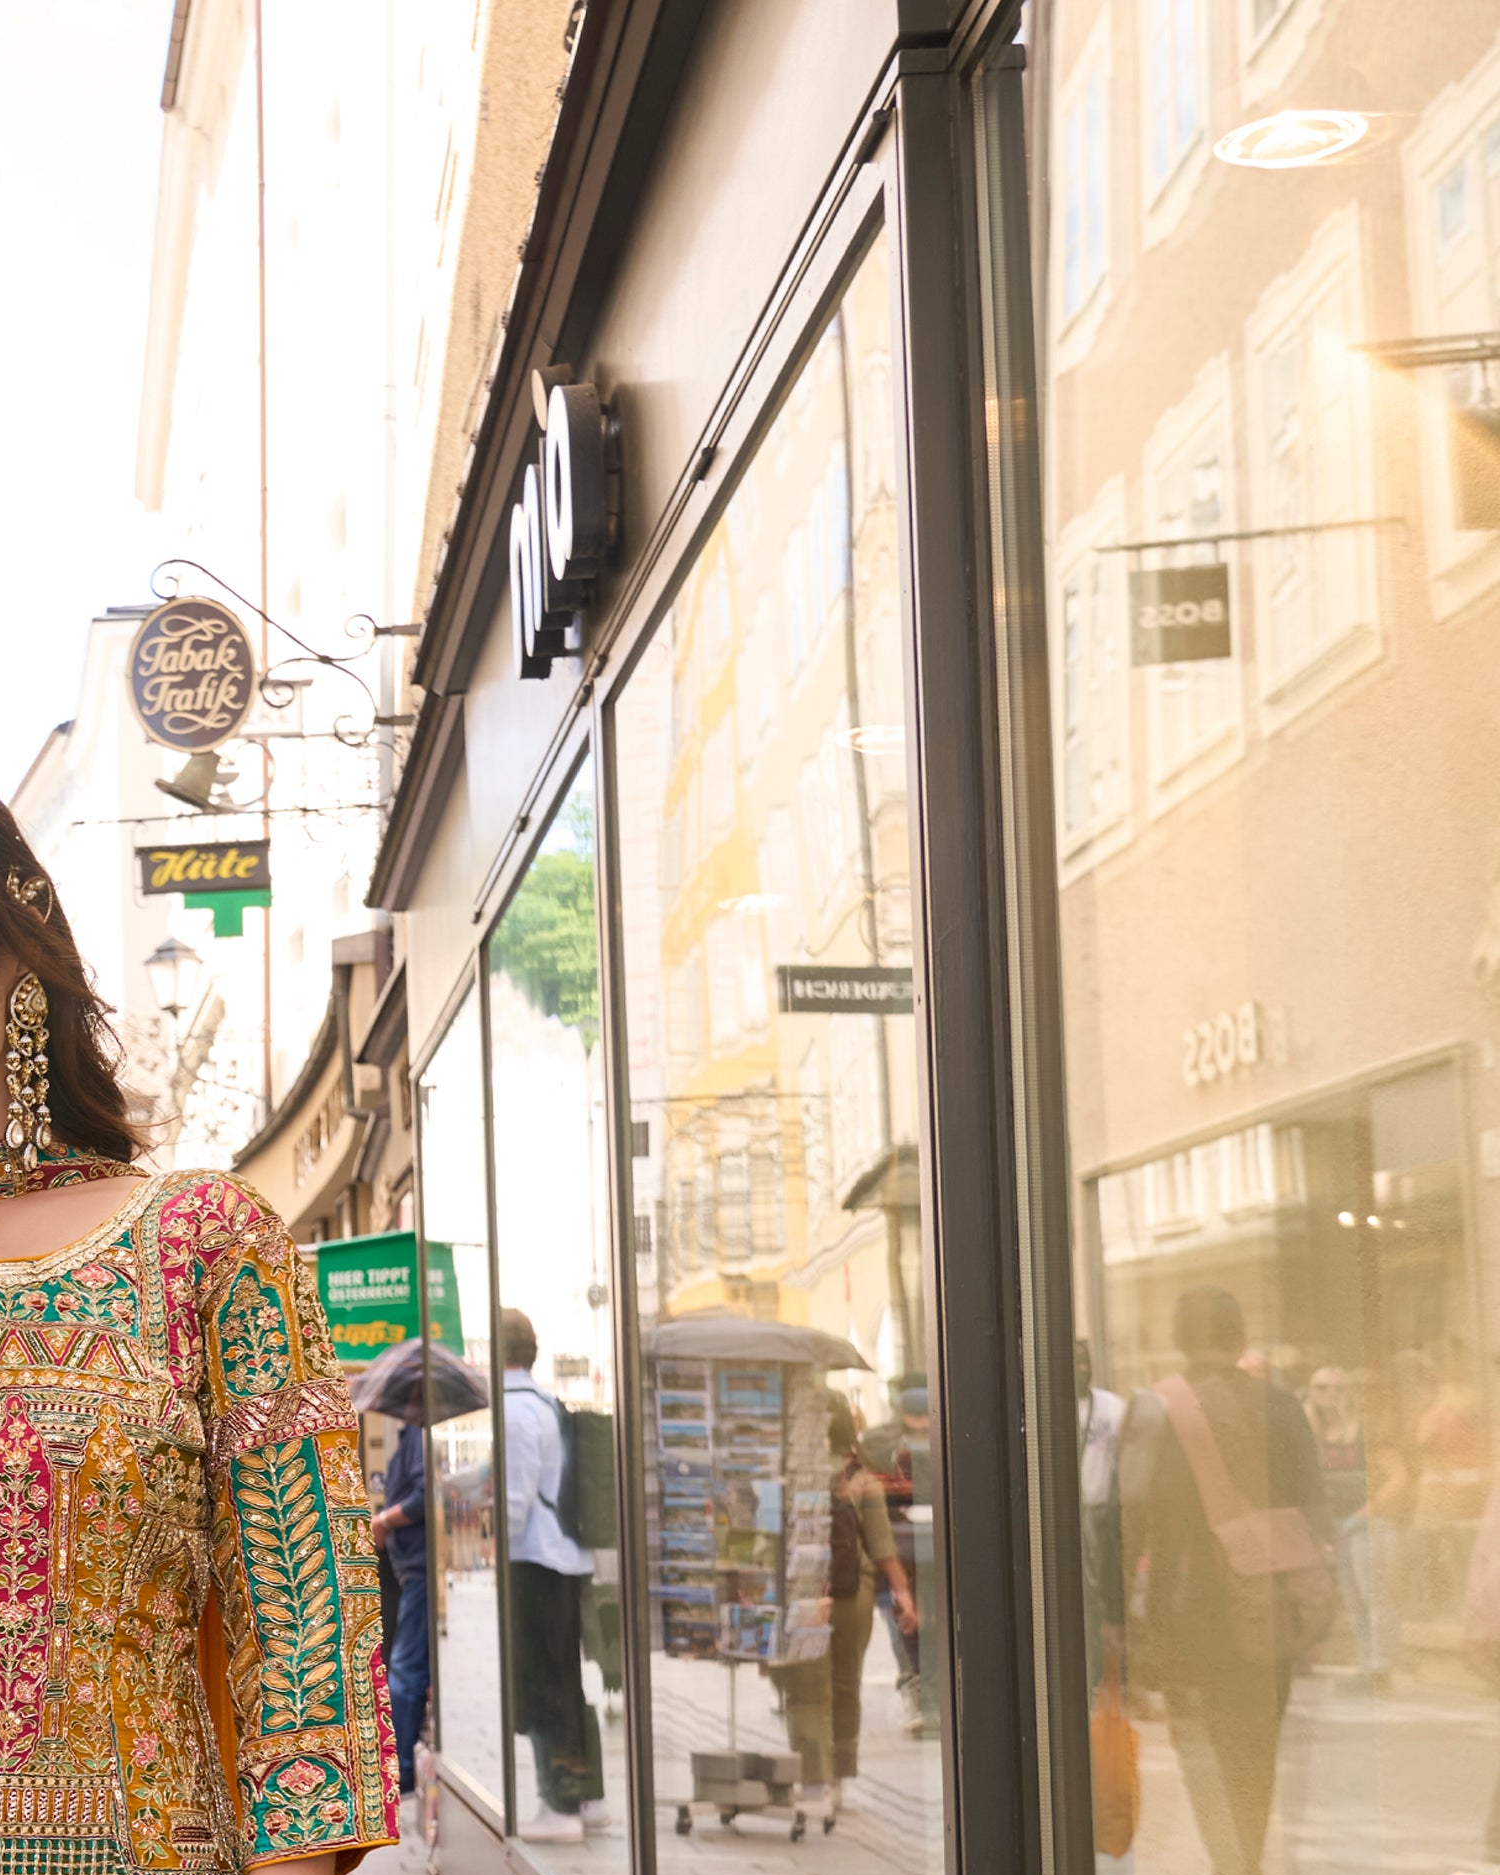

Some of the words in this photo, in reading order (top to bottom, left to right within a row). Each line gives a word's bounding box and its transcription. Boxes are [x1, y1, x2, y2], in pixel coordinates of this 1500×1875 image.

[138, 618, 244, 677] Tabak
[140, 672, 246, 731] Trafik
[148, 847, 261, 889] Hüte
[327, 1269, 364, 1287] HIER
[366, 1266, 410, 1285] TIPPT
